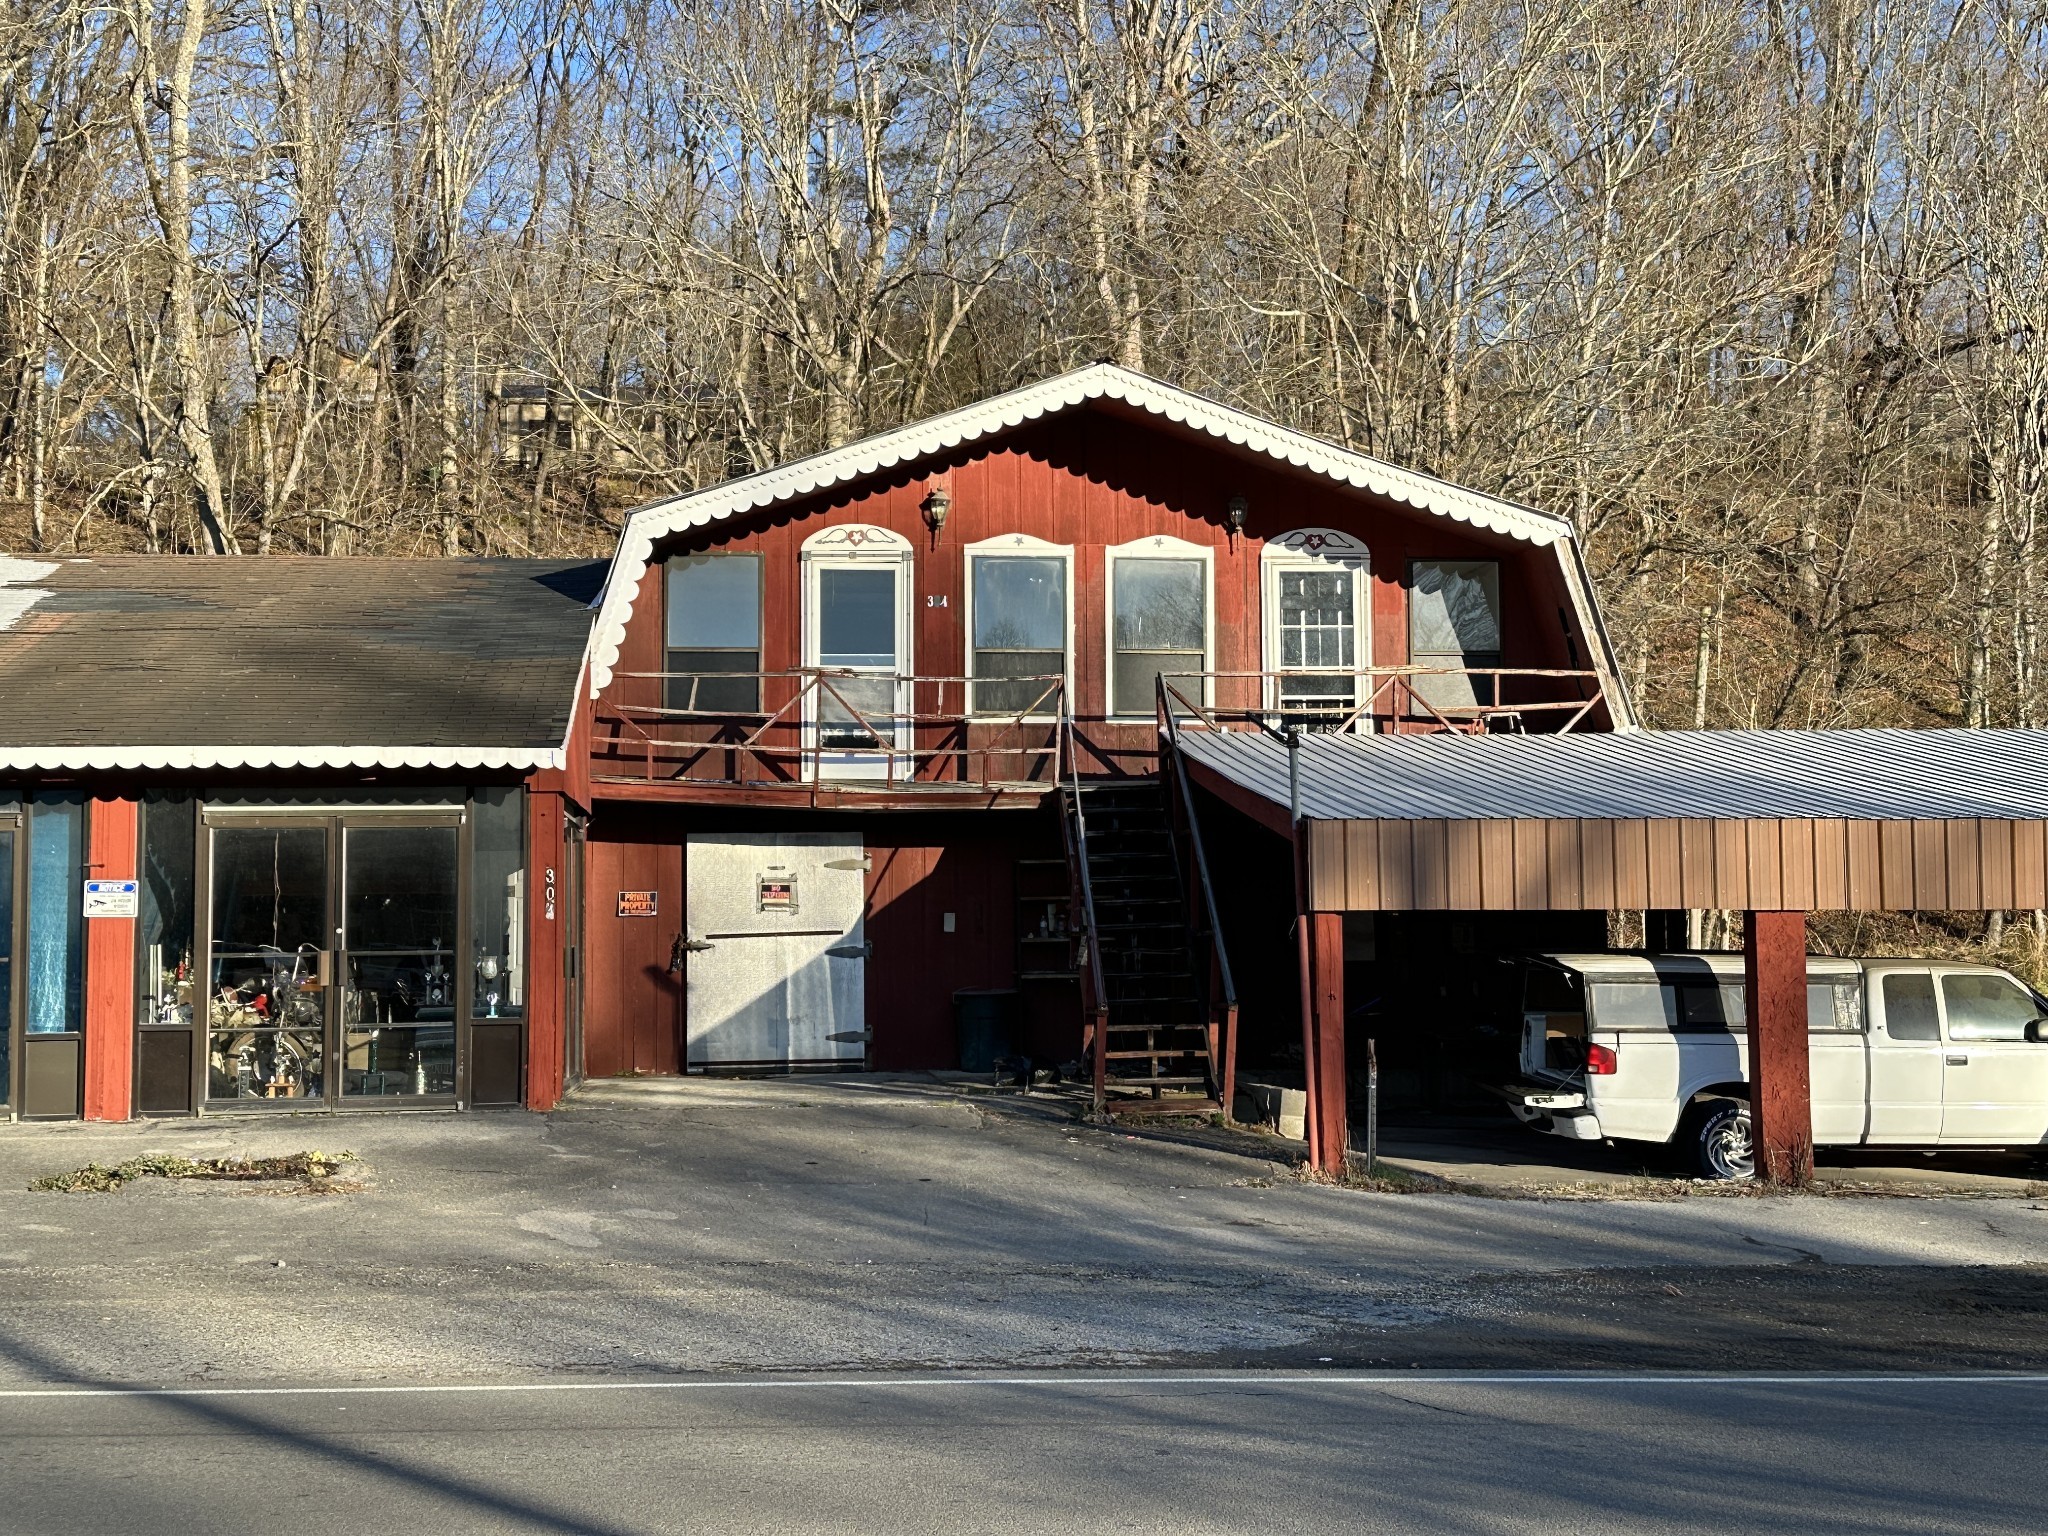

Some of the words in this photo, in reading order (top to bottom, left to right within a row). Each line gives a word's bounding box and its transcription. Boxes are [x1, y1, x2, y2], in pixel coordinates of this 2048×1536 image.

[98, 883, 125, 893] NOTICE
[771, 884, 781, 892] NO
[624, 892, 651, 902] PRIVATE
[620, 901, 655, 910] PROPERTY
